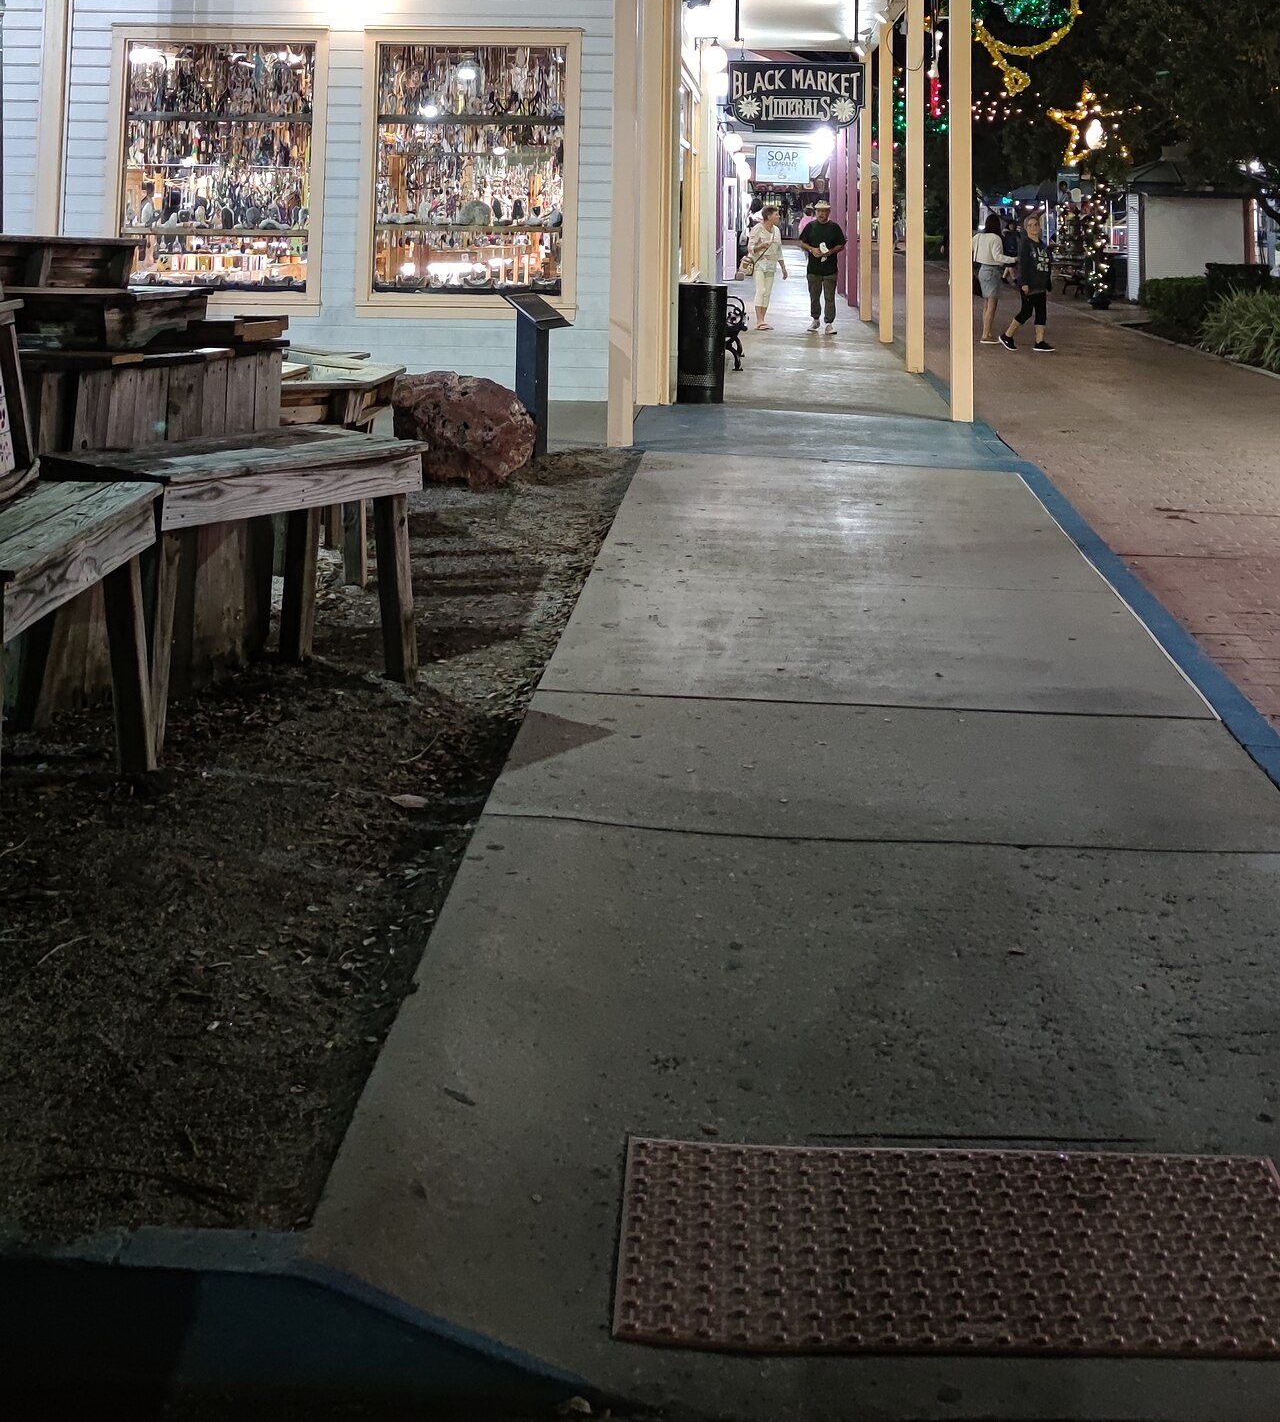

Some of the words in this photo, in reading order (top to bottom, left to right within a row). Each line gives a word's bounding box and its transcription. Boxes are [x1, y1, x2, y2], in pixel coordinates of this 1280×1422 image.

[732, 68, 787, 100] BLACK
[791, 68, 861, 101] MARKET
[760, 95, 831, 122] MINERALS
[767, 150, 799, 162] SOAP
[767, 160, 797, 168] COMPANY
